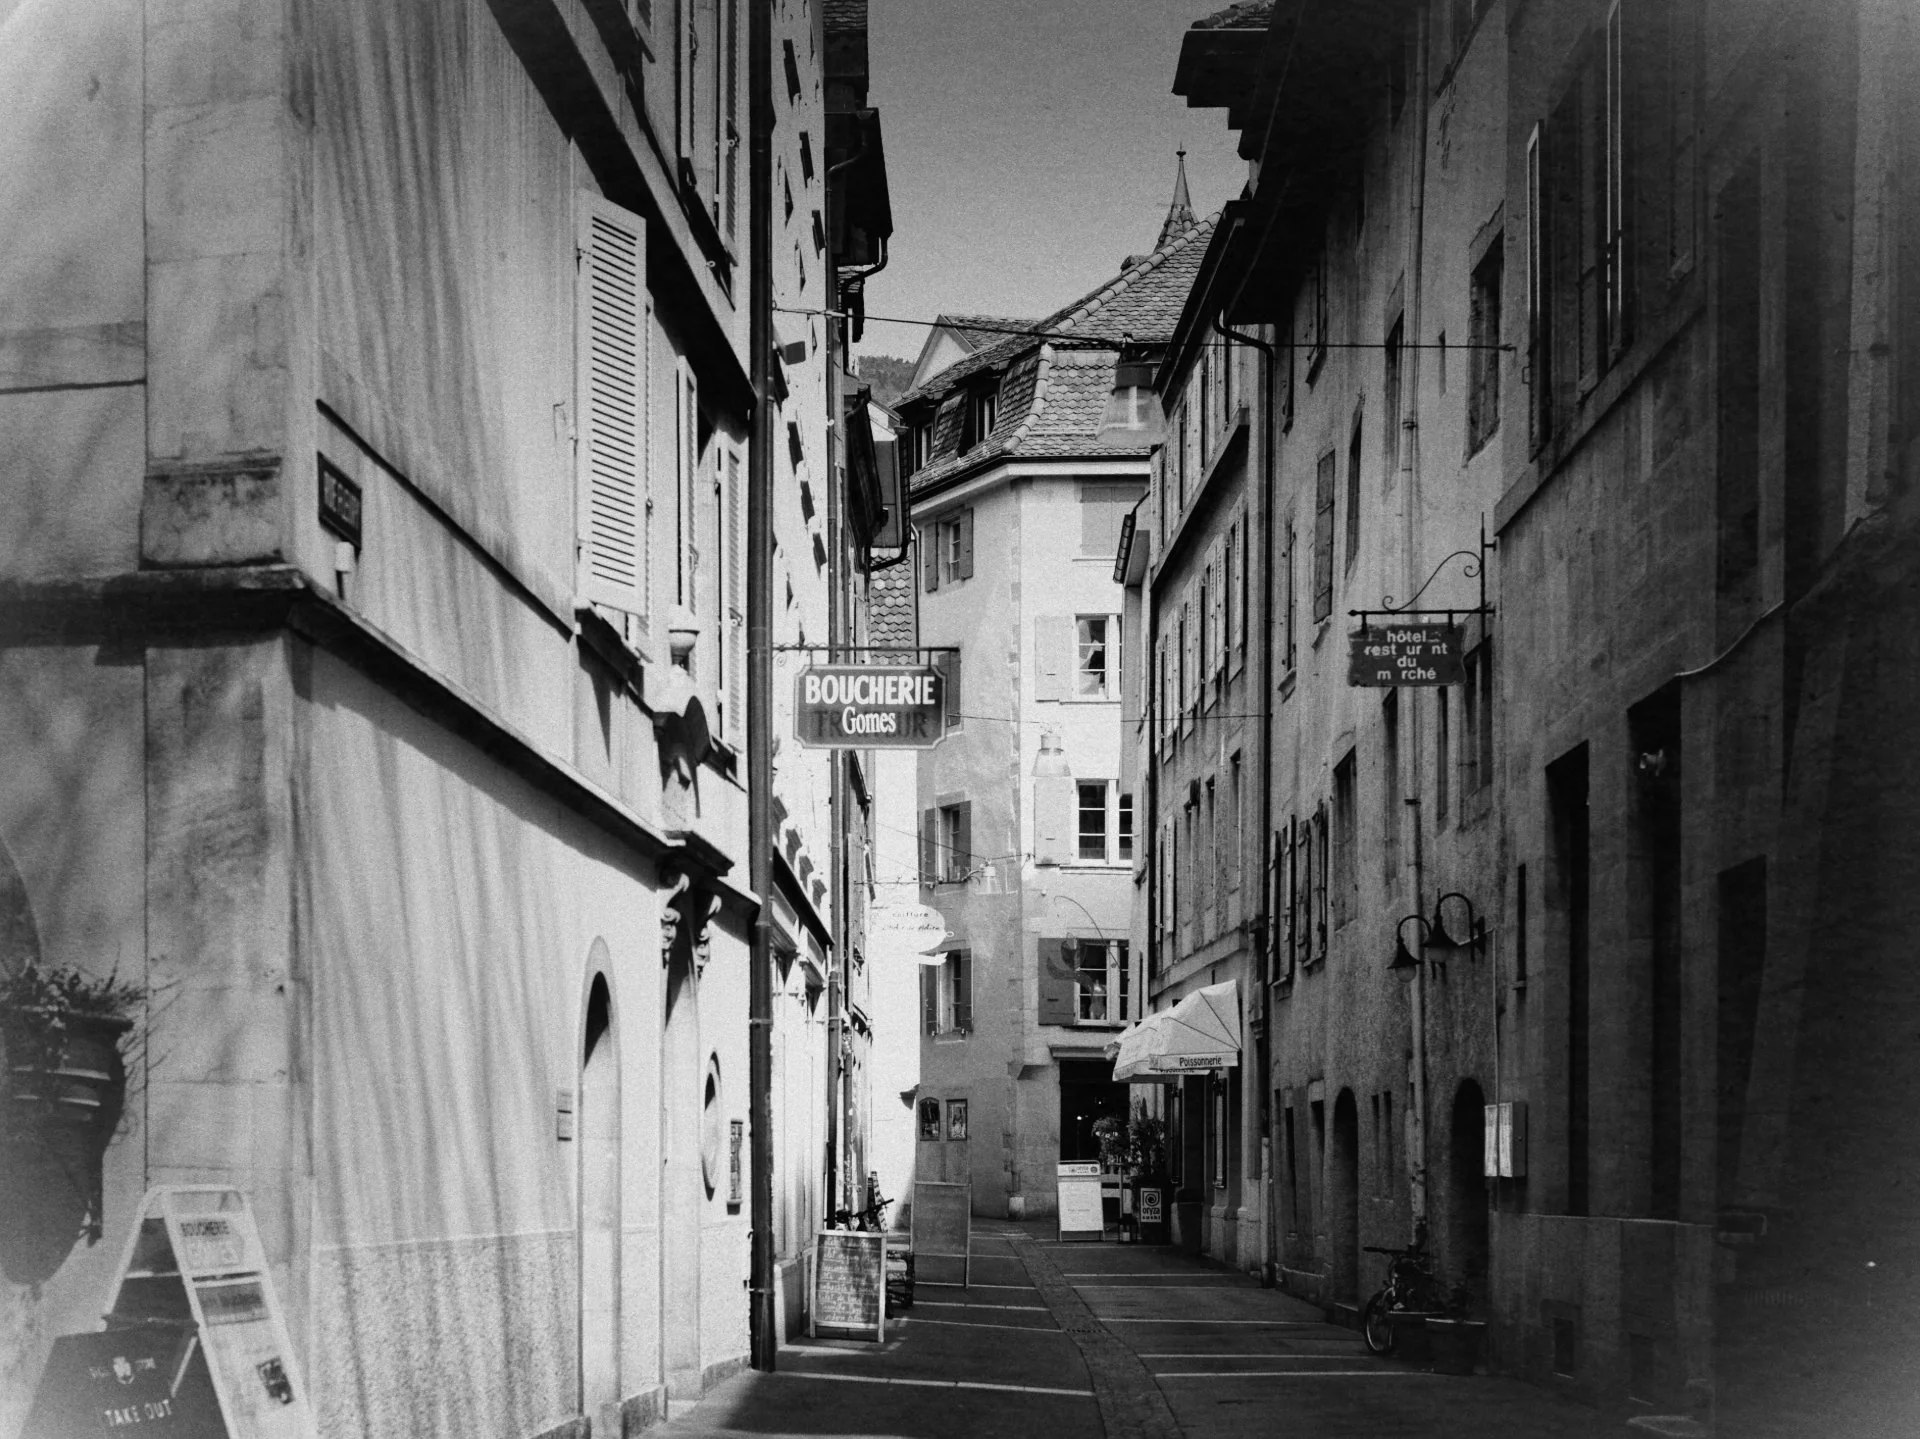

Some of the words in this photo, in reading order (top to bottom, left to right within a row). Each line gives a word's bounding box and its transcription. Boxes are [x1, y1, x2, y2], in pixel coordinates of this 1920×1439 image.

[1386, 630, 1427, 643] hôtel
[1364, 643, 1448, 656] resturnt
[1396, 655, 1417, 668] du
[1376, 667, 1437, 680] mrché
[805, 675, 936, 705] BOUCHERIE
[842, 706, 897, 735] Gomes
[1179, 1056, 1222, 1067] Poissonnerie
[1142, 1207, 1161, 1215] oryza
[104, 1405, 141, 1427] TAKE
[144, 1399, 172, 1420] OUT
